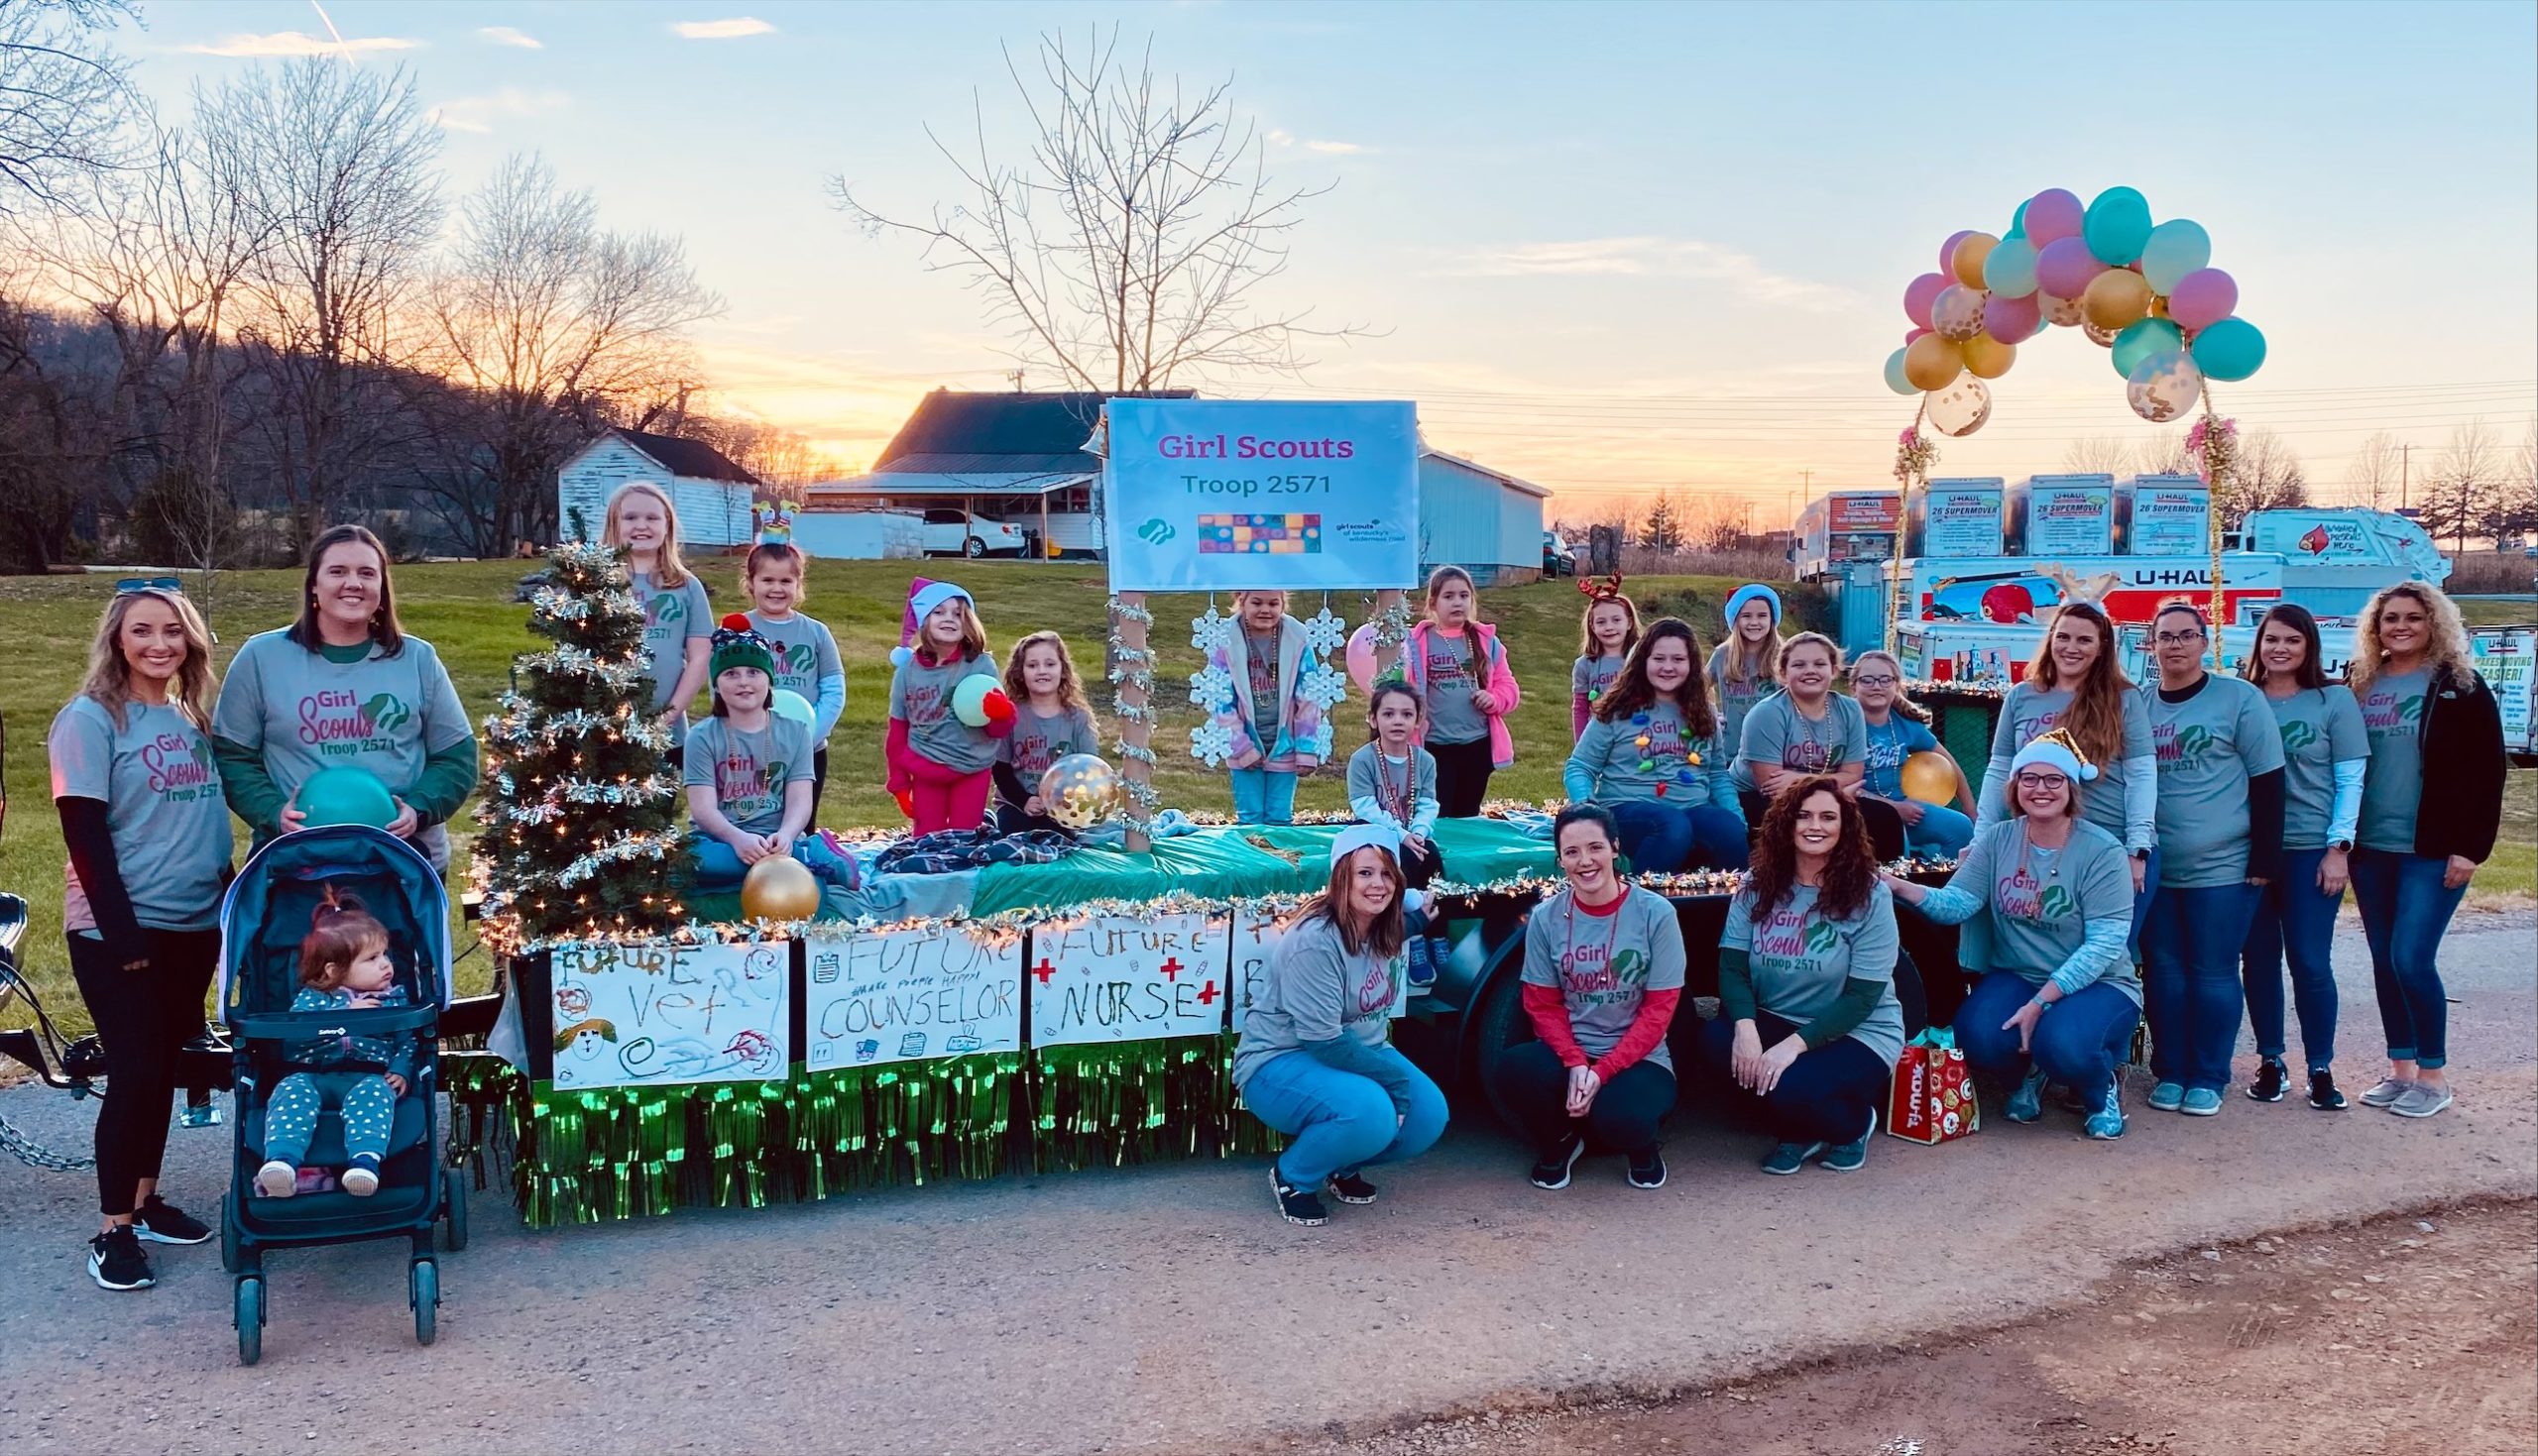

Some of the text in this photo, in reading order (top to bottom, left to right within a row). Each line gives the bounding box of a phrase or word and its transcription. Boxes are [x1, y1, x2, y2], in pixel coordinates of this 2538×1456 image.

[1158, 434, 1354, 459] Girl Scouts
[1181, 475, 1330, 498] Troop 2571
[2135, 570, 2231, 585] U-HAUL
[782, 676, 807, 687] 2571
[317, 689, 357, 708] Girl
[2367, 693, 2397, 707] Girl
[298, 696, 377, 745] Scouts
[1653, 720, 1677, 733] Girl
[2388, 726, 2415, 736] 2571
[156, 733, 187, 751] Girl
[317, 737, 396, 756] Troop 2571
[199, 783, 218, 798] 257
[2013, 873, 2039, 891] Girl
[1775, 910, 1805, 929] Girl
[1059, 928, 1207, 960] FUTURE
[1574, 943, 1607, 962] Girl
[1761, 954, 1822, 972] Troop 2571
[629, 983, 726, 1035] Vet
[820, 979, 1016, 1039] COUNSELOR
[1061, 981, 1207, 1031] NURSE
